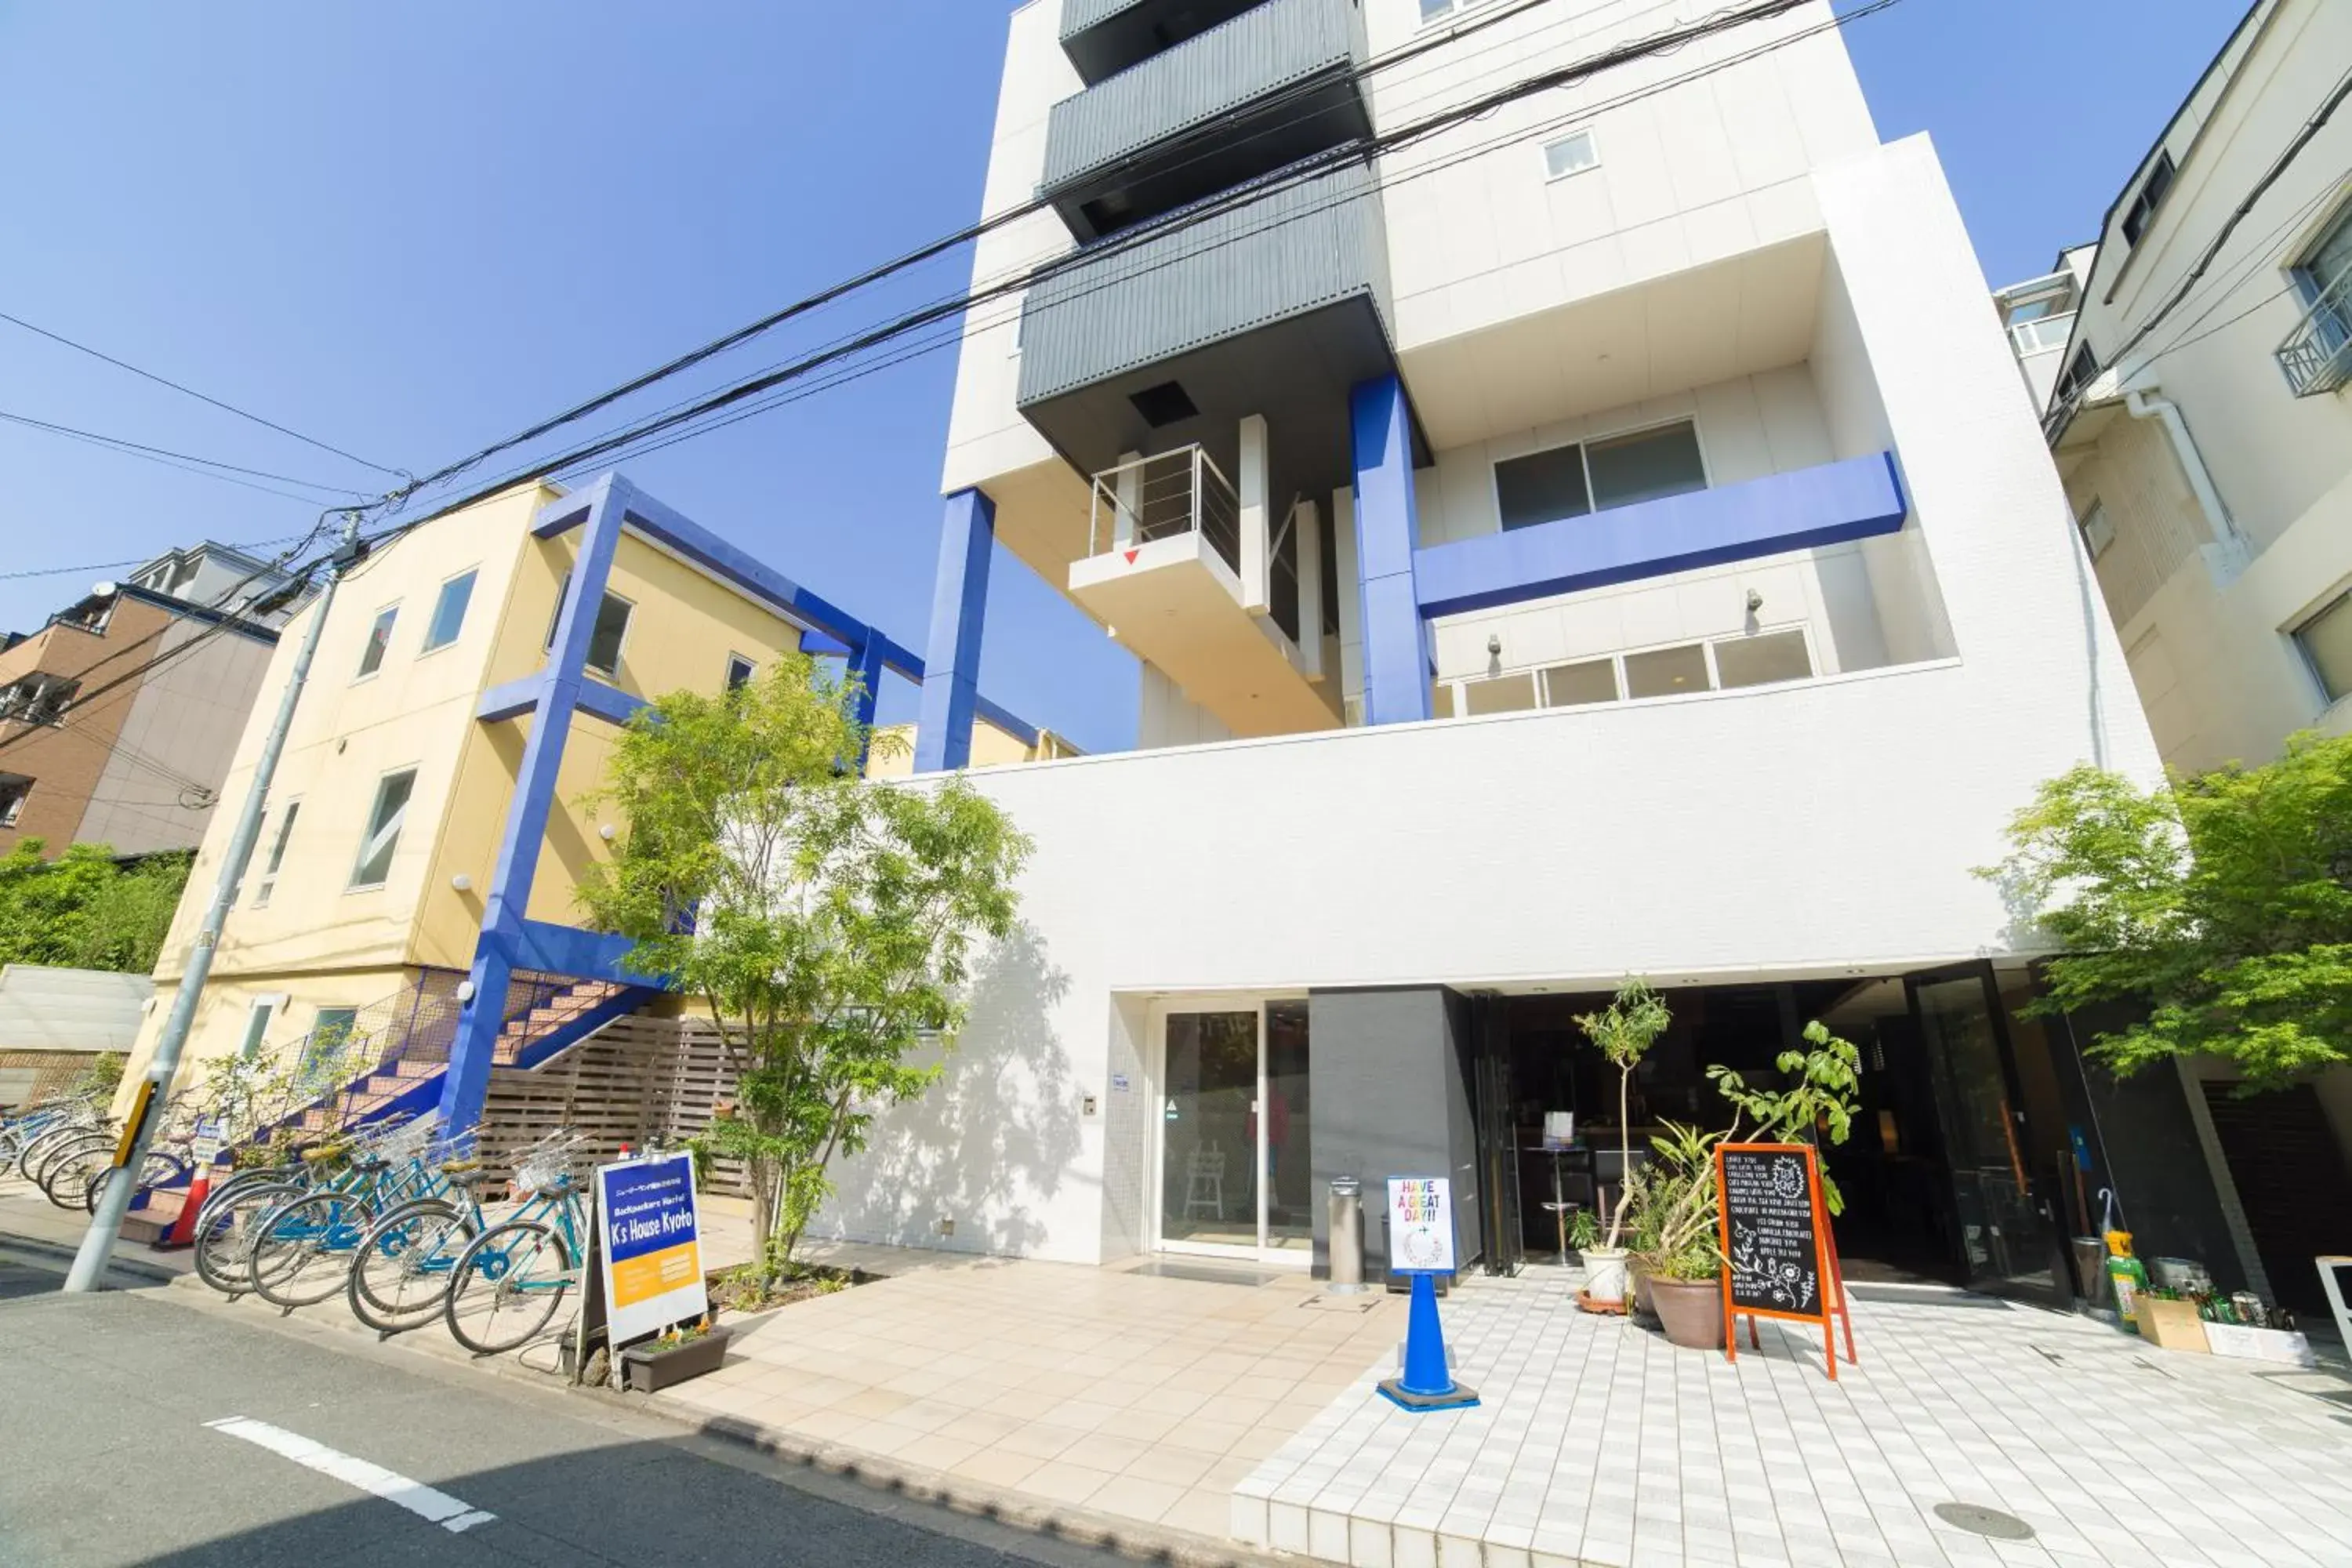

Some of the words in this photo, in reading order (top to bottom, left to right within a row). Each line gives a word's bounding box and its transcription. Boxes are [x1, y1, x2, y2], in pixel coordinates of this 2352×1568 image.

[1402, 1181, 1435, 1192] HAVE
[1398, 1195, 1406, 1208] A
[1407, 1195, 1440, 1208] GREAT
[630, 1218, 661, 1242] House
[662, 1207, 692, 1233] Kyoto
